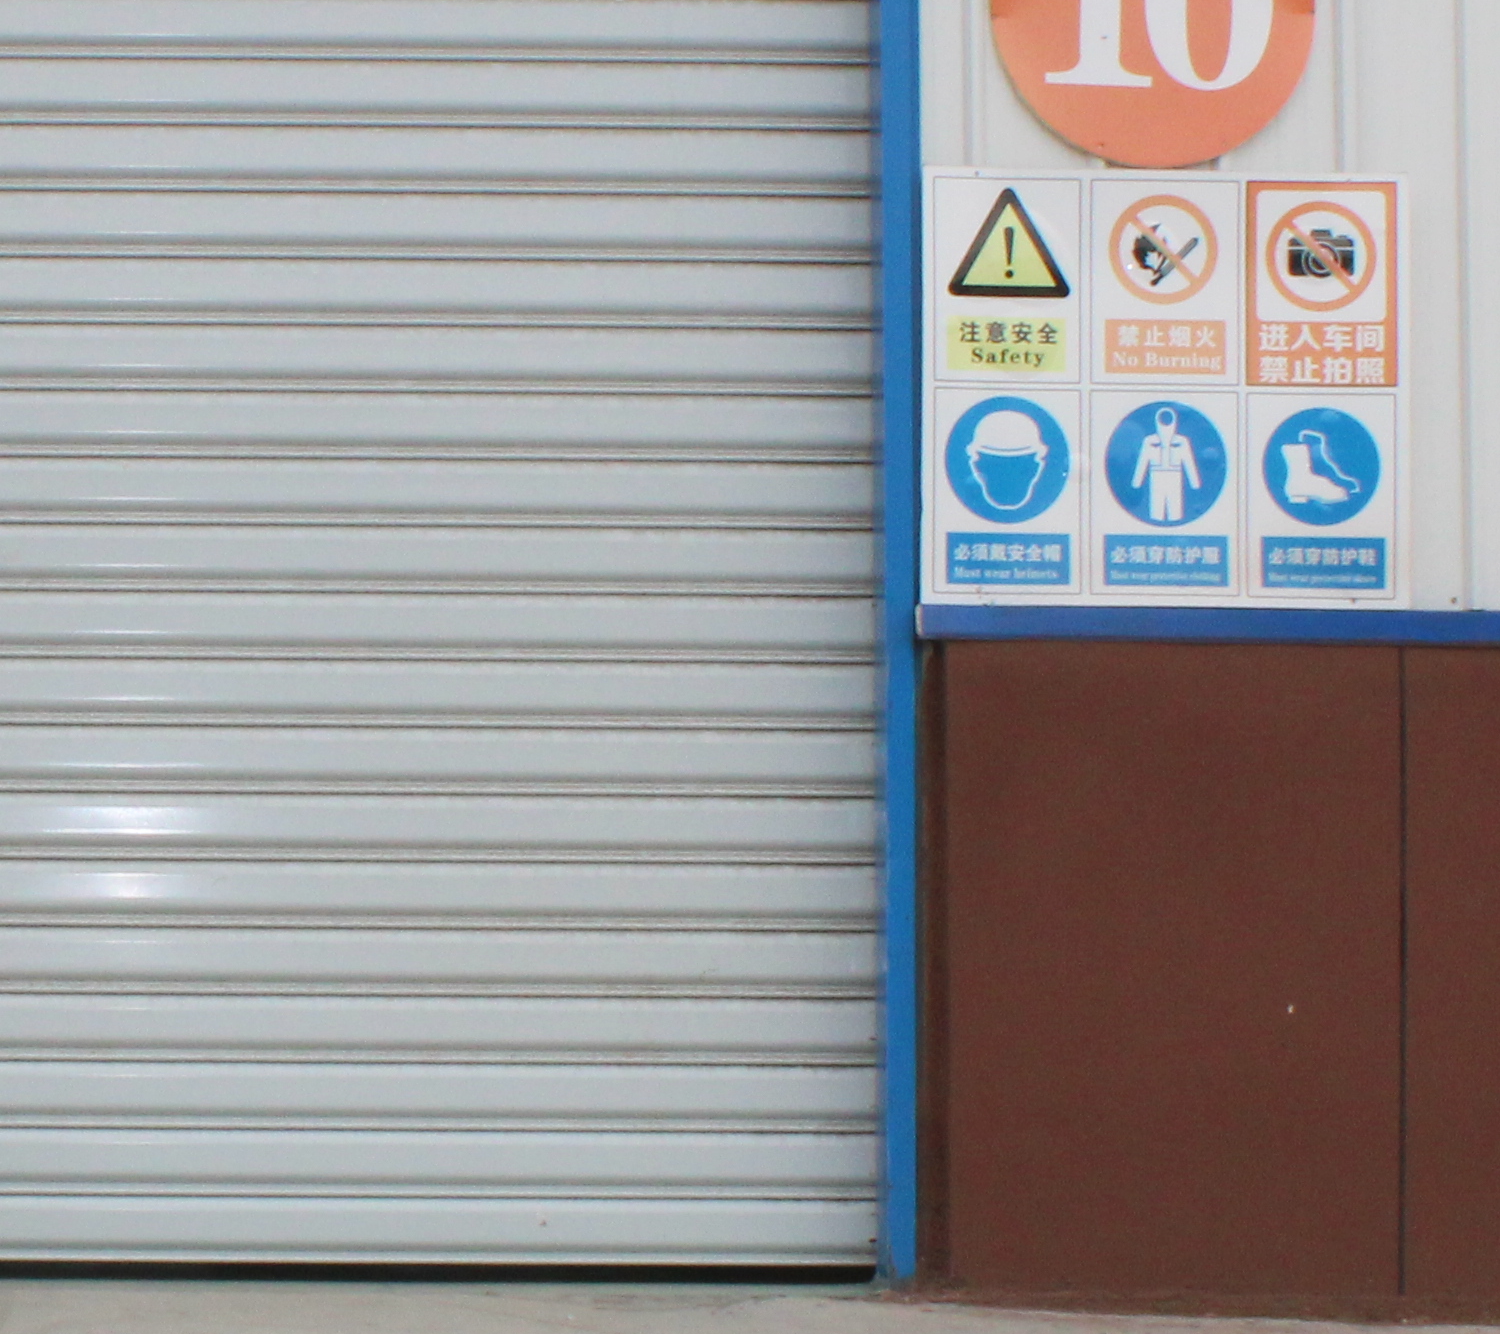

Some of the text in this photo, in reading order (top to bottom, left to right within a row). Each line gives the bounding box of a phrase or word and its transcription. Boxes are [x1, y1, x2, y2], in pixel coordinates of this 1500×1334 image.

[959, 321, 1058, 344] 注意安全
[1117, 324, 1217, 347] 禁止烟火
[1258, 323, 1386, 352] 进入车间
[971, 347, 1045, 368] Safety
[1113, 351, 1223, 371] No Burning
[1258, 355, 1386, 384] 禁止拍照
